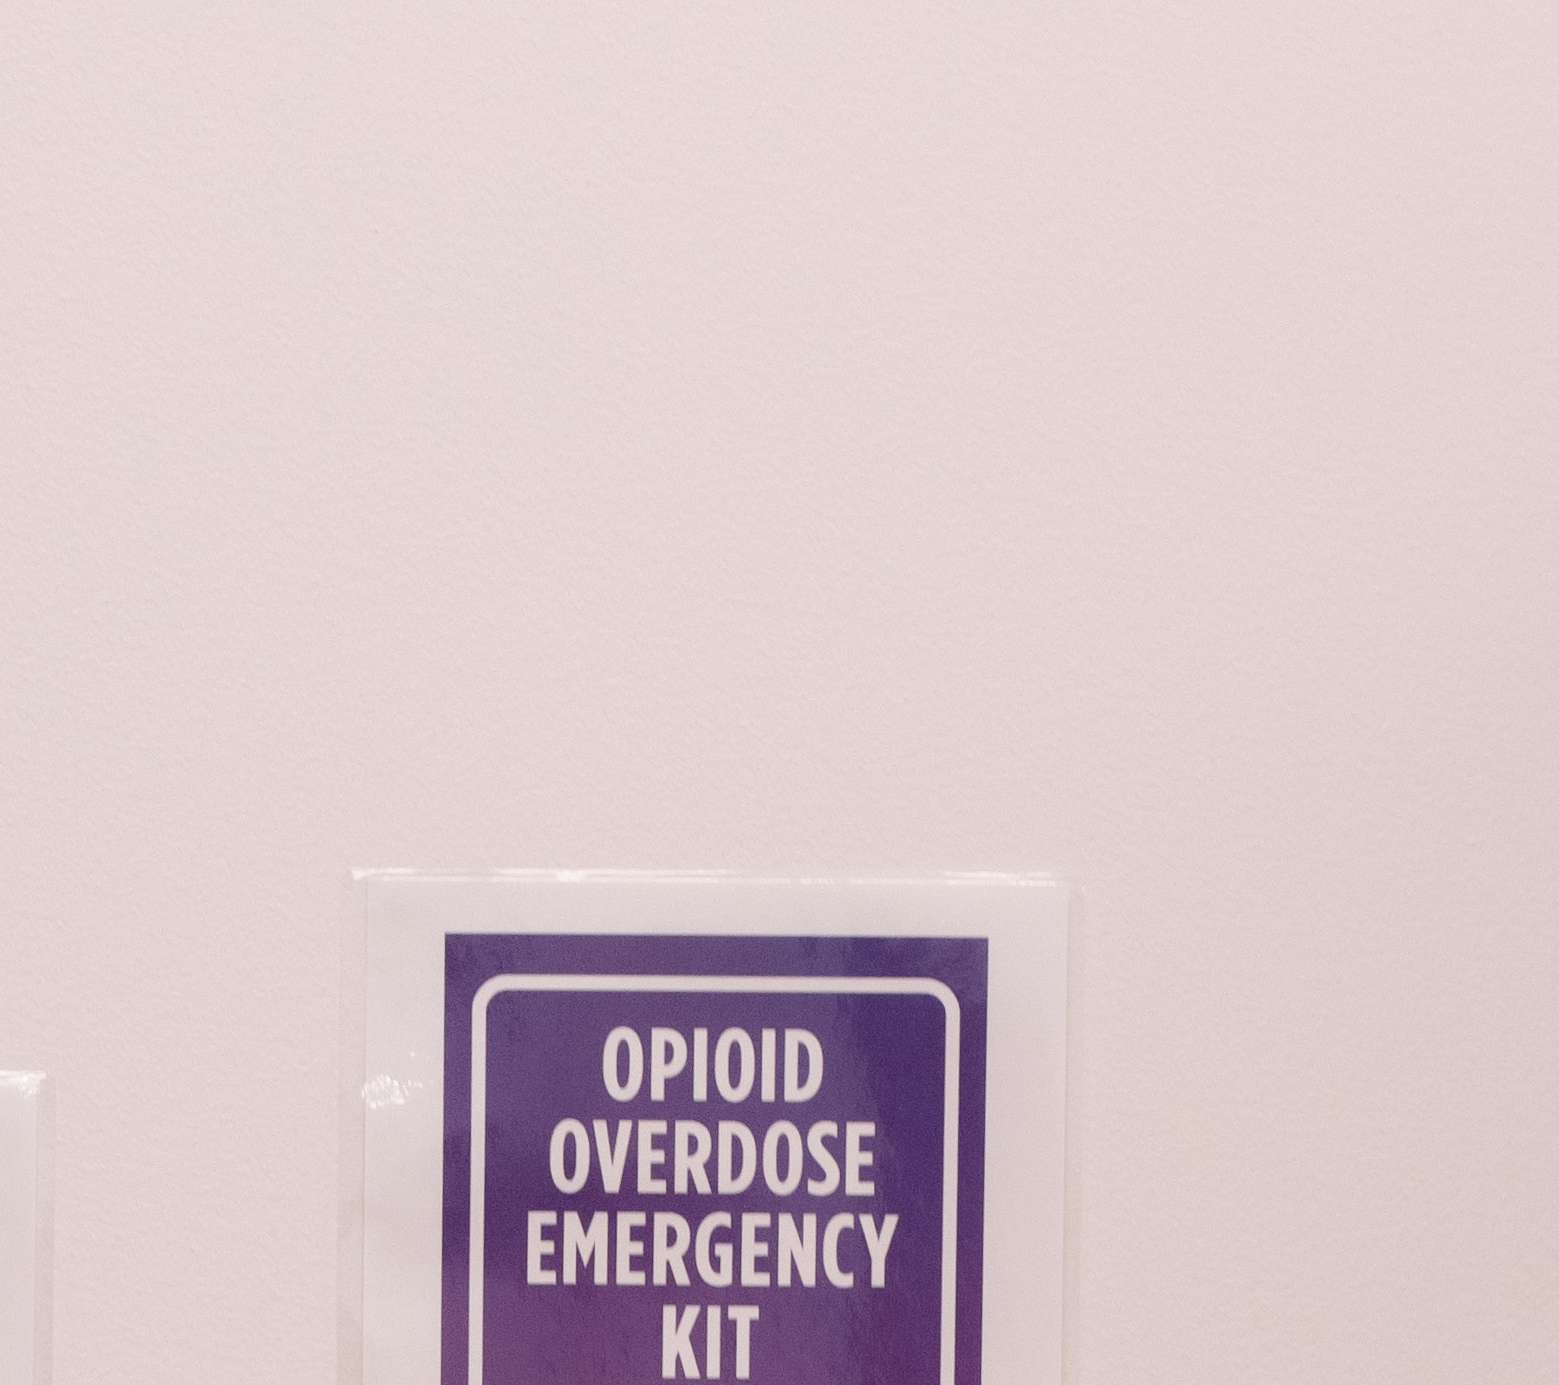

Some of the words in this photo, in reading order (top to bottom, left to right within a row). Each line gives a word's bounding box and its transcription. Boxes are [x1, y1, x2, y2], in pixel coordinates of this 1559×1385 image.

[601, 1025, 825, 1104] OPIOID
[548, 1119, 877, 1198] OVERDOSE
[526, 1210, 900, 1290] EMERGENCY
[661, 1304, 760, 1380] KIT
